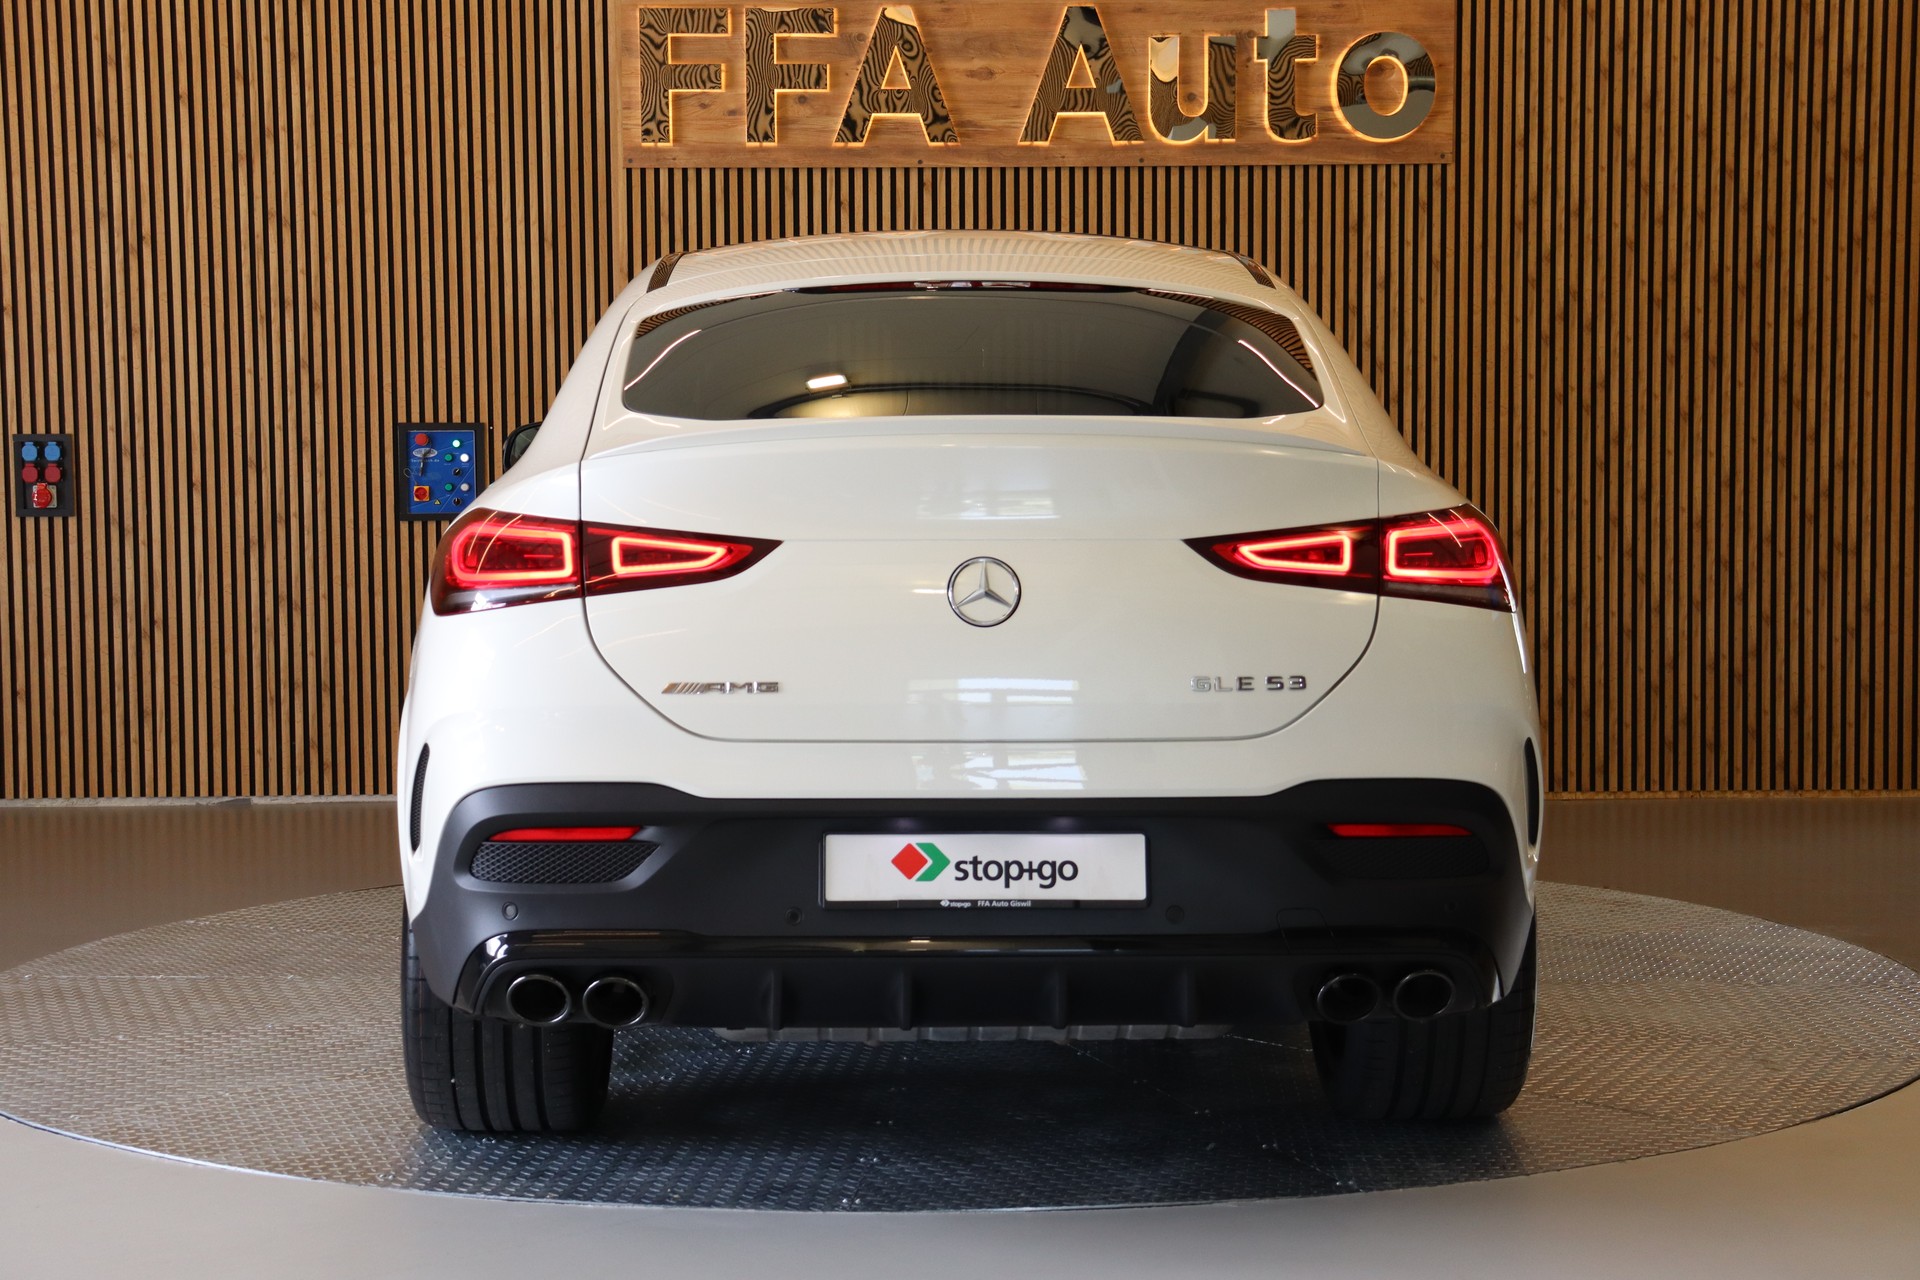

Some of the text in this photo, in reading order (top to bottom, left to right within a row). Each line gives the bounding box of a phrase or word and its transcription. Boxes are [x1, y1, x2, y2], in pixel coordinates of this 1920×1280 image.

[638, 4, 1440, 149] FFA Auto
[701, 681, 779, 694] AMG
[1190, 675, 1307, 692] GLE 53
[954, 855, 1079, 889] stop+go
